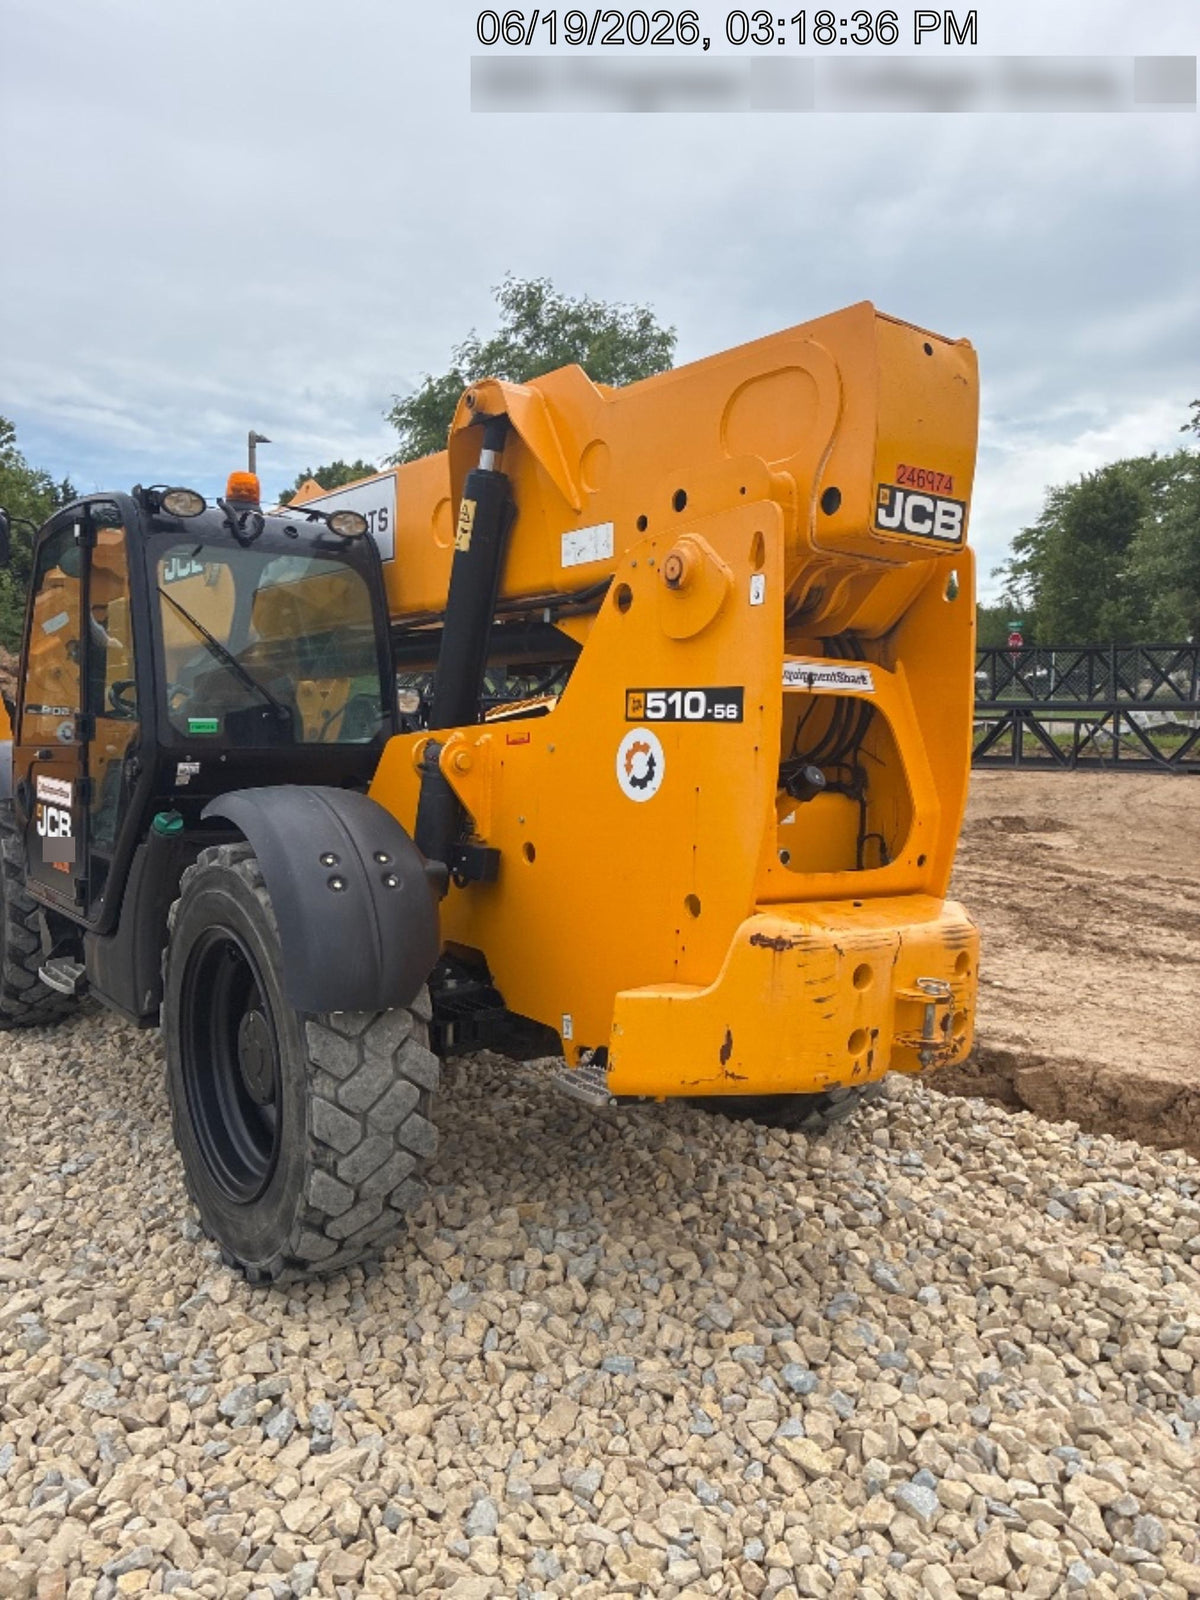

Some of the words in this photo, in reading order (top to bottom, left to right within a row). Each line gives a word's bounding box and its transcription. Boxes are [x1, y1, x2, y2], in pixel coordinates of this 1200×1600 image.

[896, 464, 953, 492] 246974
[363, 507, 388, 534] TS
[878, 491, 963, 540] JCB
[37, 804, 72, 838] JCB
